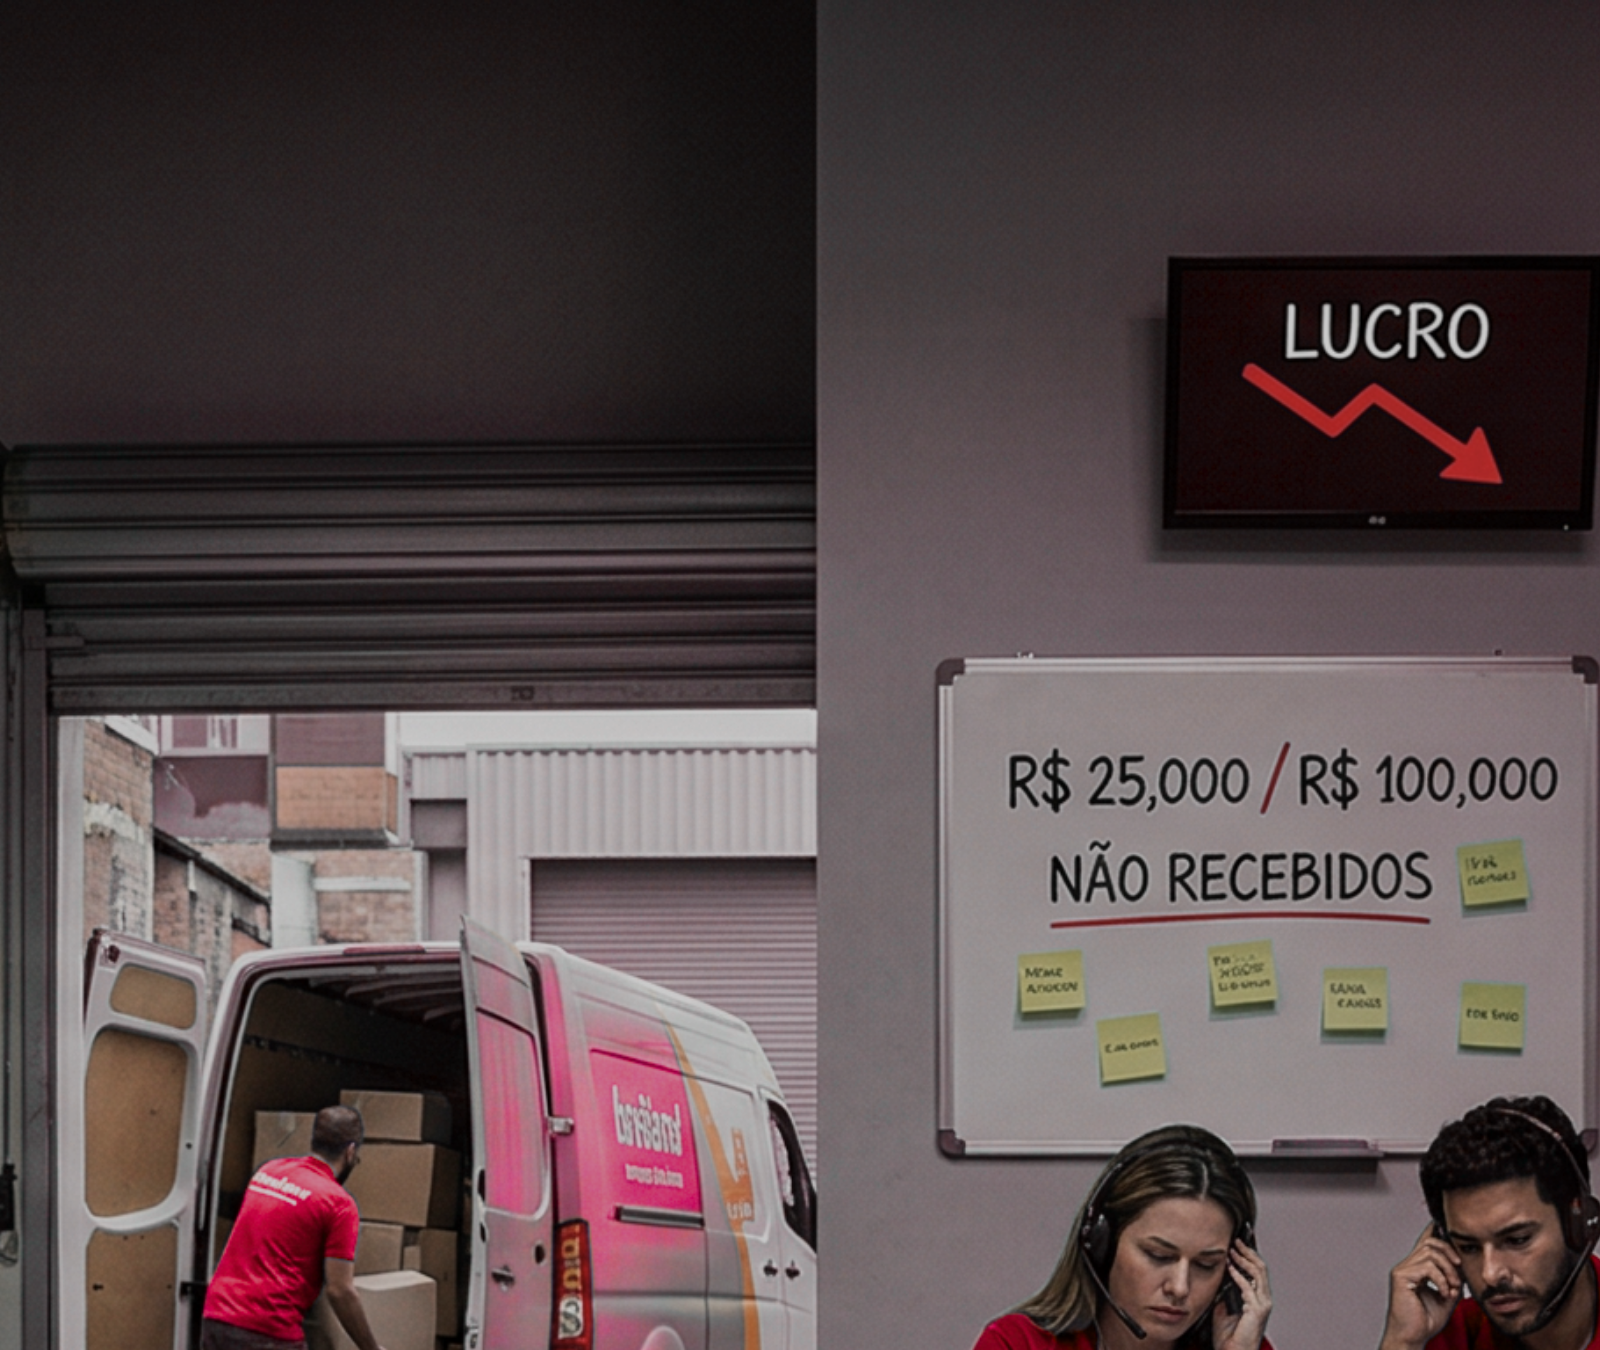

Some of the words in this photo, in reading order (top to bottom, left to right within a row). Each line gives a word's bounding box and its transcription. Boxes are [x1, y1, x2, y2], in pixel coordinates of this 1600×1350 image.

[1285, 301, 1491, 360] LUCRO
[1008, 747, 1071, 813] R$
[1086, 755, 1251, 813] 25,000
[1299, 748, 1359, 811] R$
[1375, 755, 1559, 809] 100,000
[1049, 839, 1149, 902] NÃO
[1169, 851, 1433, 902] RECEBIDOS
